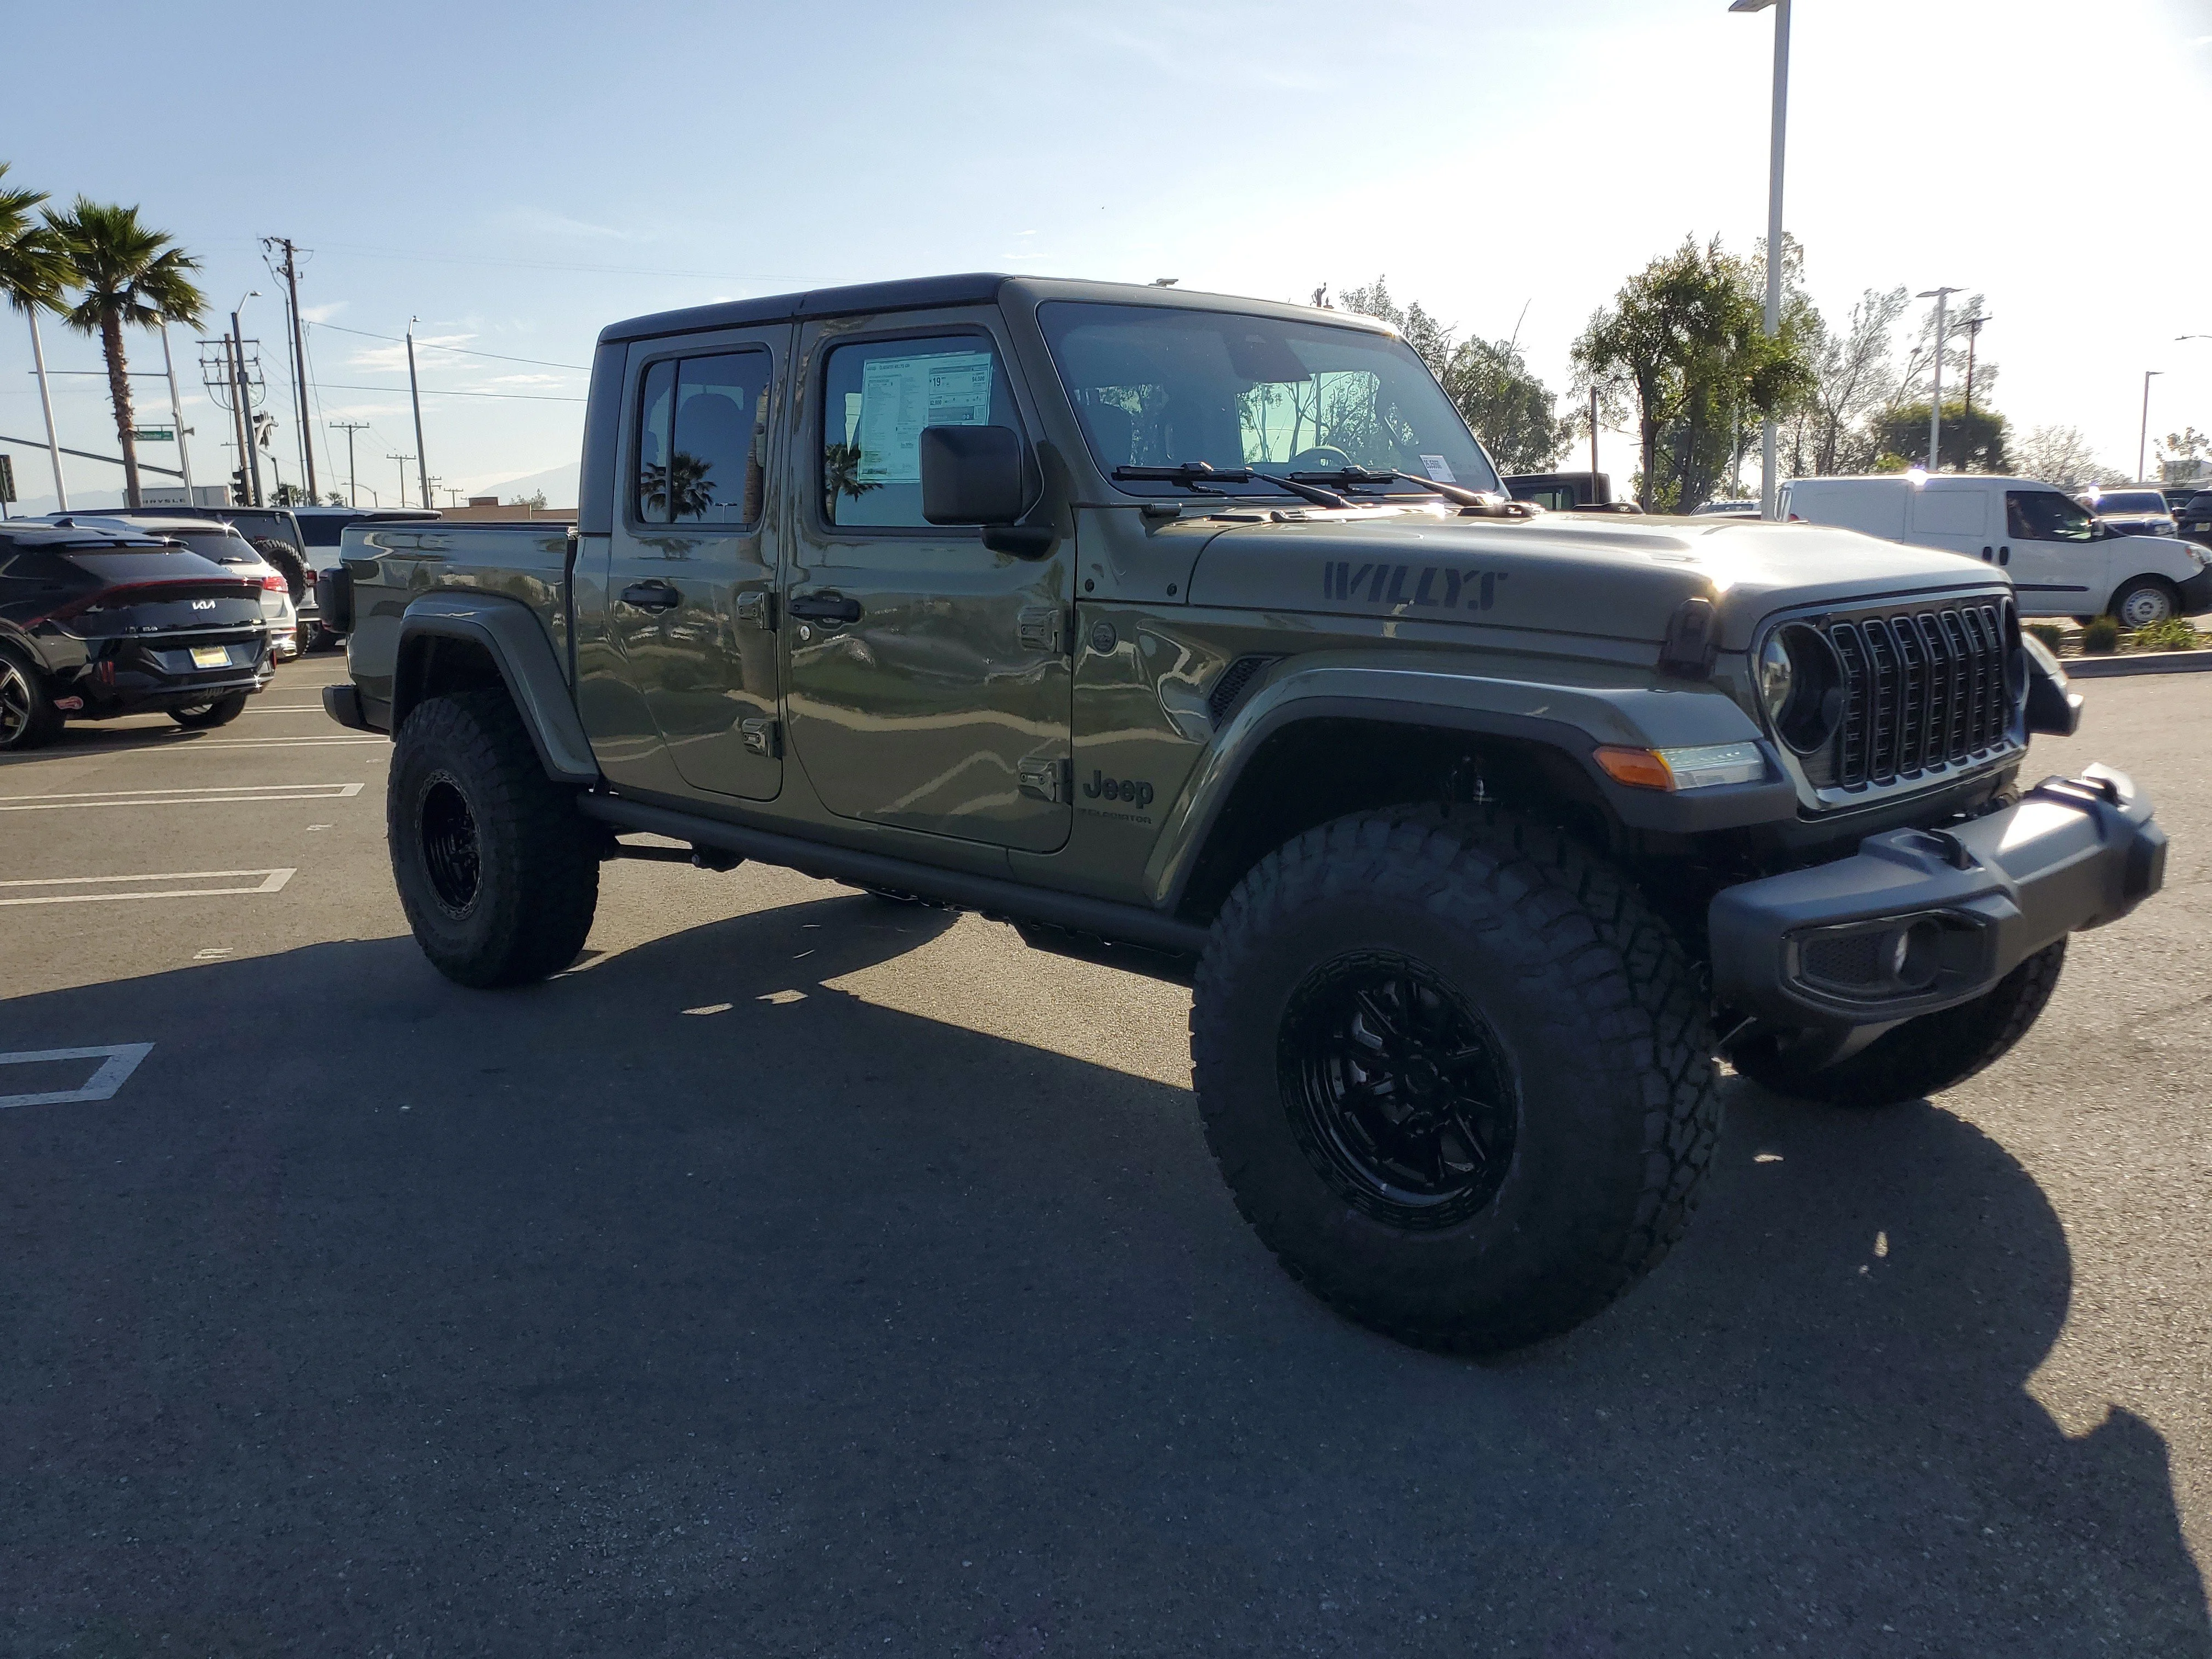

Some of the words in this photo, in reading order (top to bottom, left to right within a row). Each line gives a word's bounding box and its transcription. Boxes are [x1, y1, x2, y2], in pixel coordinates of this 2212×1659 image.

[933, 377, 941, 387] 19
[1323, 561, 1508, 611] WILLYS
[192, 600, 216, 610] KIA
[1083, 770, 1154, 809] Jeep
